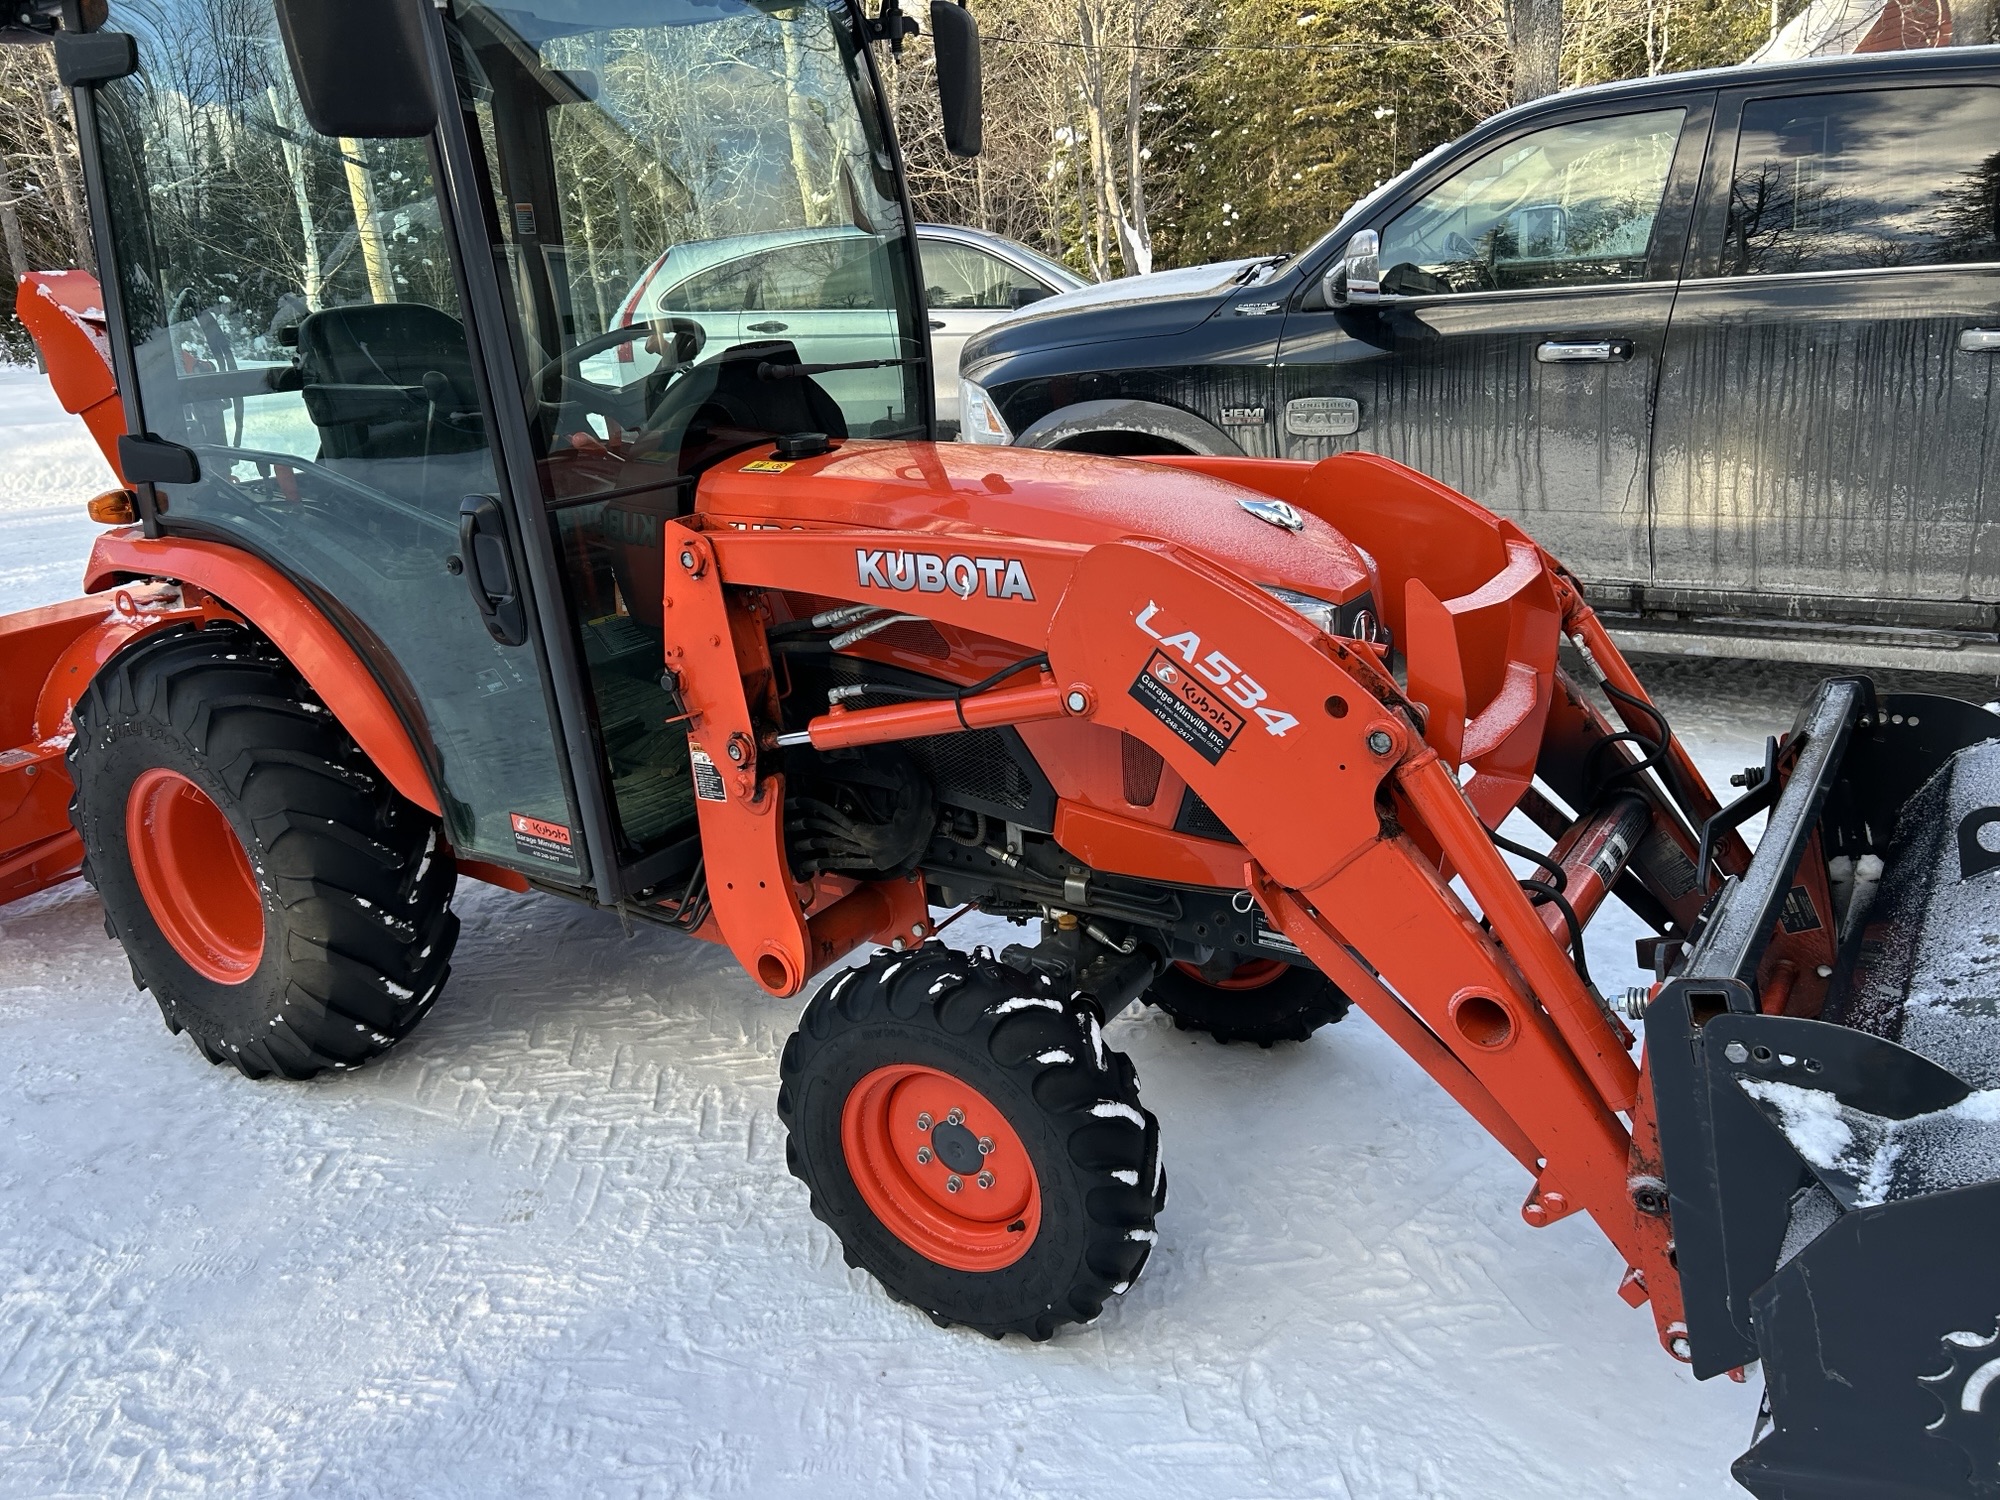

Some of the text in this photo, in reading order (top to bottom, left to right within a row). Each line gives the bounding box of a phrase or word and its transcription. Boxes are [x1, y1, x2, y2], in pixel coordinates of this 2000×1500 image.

[1221, 408, 1264, 418] HEMI
[1290, 412, 1353, 425] RAM
[856, 549, 1036, 601] KUBOTA
[1135, 600, 1300, 738] LA534
[1141, 674, 1174, 704] Garage
[1174, 701, 1208, 733] Minville
[1208, 730, 1225, 748] inc.
[1181, 682, 1232, 733] Kubota
[1154, 708, 1195, 742] 418 248-2477
[515, 832, 537, 845] Garage
[533, 823, 568, 841] Kubota
